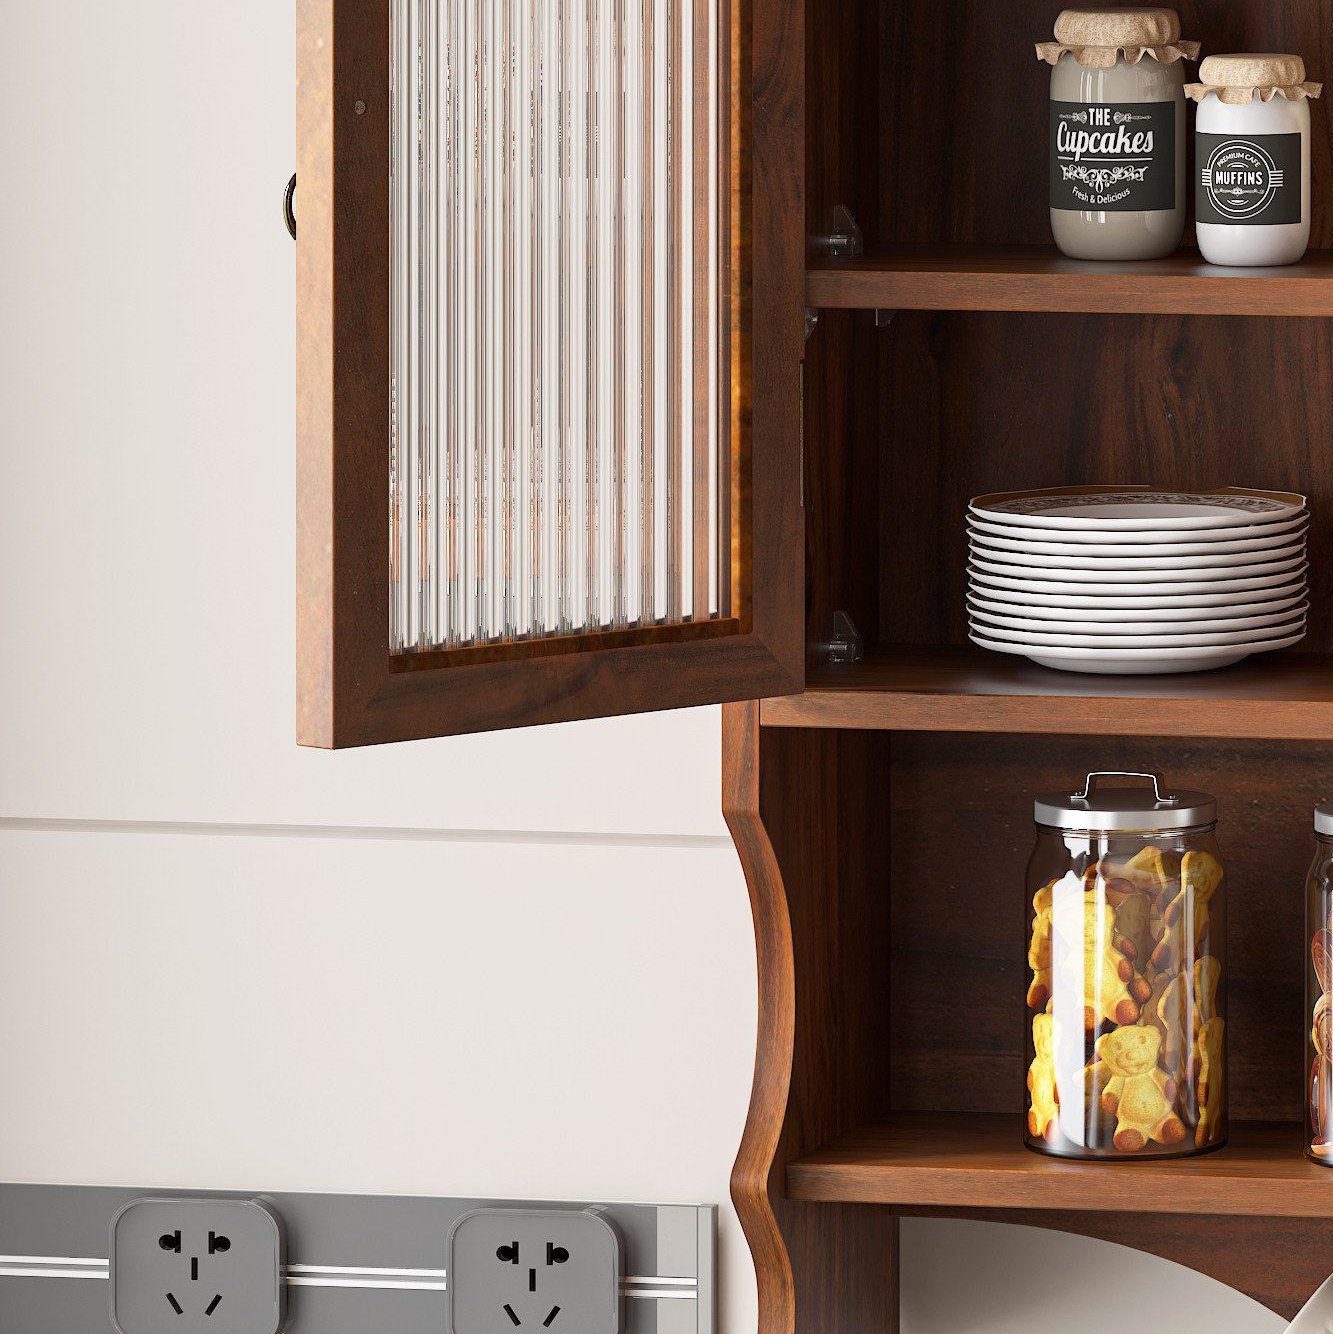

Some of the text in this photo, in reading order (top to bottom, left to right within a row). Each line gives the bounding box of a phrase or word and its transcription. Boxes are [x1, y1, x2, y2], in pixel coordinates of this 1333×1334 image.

[1088, 108, 1111, 126] THE
[1057, 121, 1154, 162] Cupcakes
[1217, 152, 1261, 168] PREMIUM CAFE
[1215, 170, 1263, 185] MUFFINS
[1072, 186, 1131, 204] Fresh & Delicious
